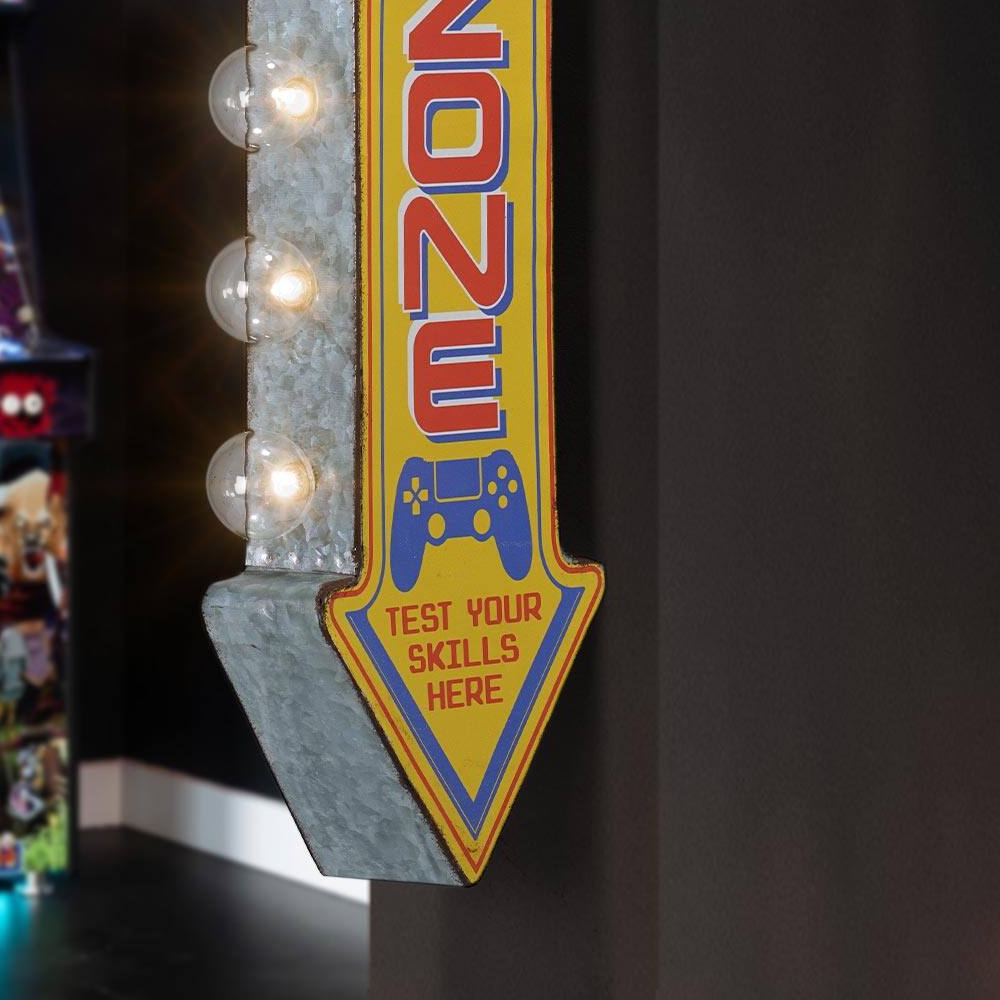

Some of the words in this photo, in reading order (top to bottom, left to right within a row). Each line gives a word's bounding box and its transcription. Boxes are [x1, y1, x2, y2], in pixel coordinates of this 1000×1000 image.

[385, 601, 452, 636] TEST
[467, 592, 542, 627] YOUR
[408, 633, 520, 674] SKILLS
[427, 674, 504, 712] HERE
